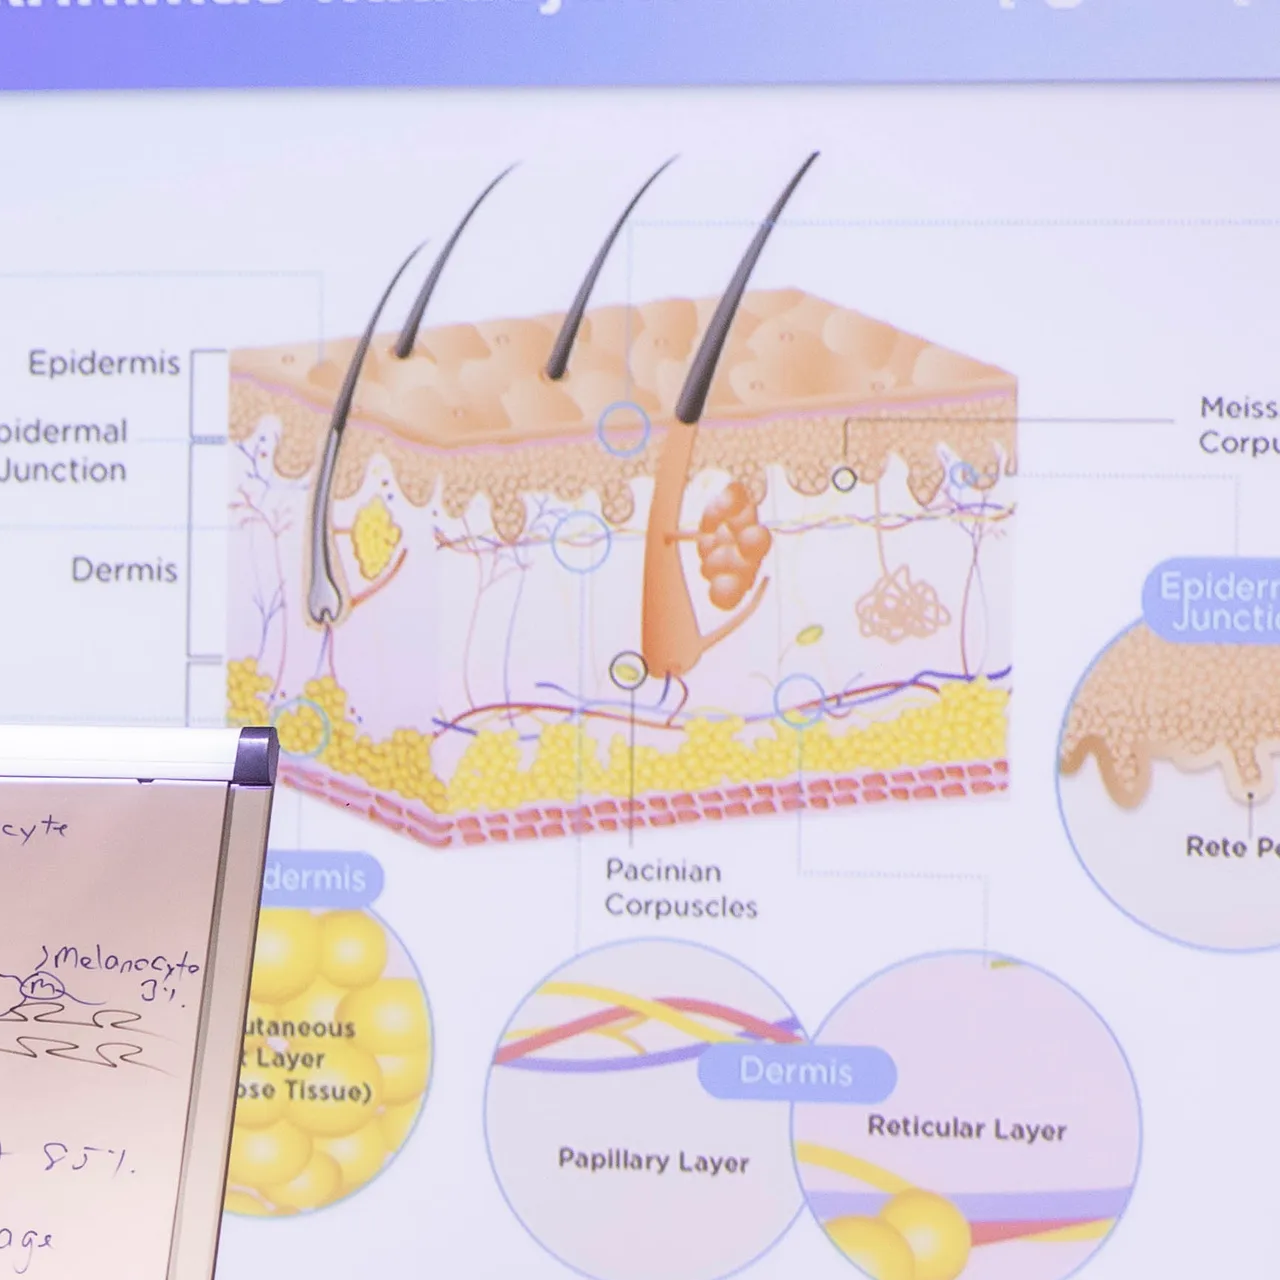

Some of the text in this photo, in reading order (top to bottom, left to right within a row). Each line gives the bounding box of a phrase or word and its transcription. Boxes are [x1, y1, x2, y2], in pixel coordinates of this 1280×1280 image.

[29, 349, 181, 380] Epidermis
[71, 556, 178, 583] Dermis
[1186, 835, 1248, 858] Rete
[262, 864, 368, 892] dermis
[606, 857, 722, 883] Pacinian
[604, 892, 759, 921] Corpuscles
[242, 1018, 356, 1040] utaneous
[256, 1047, 325, 1073] Layer
[740, 1055, 853, 1087] Dermis
[236, 1078, 372, 1106] ose Tissue)
[868, 1113, 1068, 1143] Reticular Layer
[558, 1147, 750, 1175] Papillary Layer
